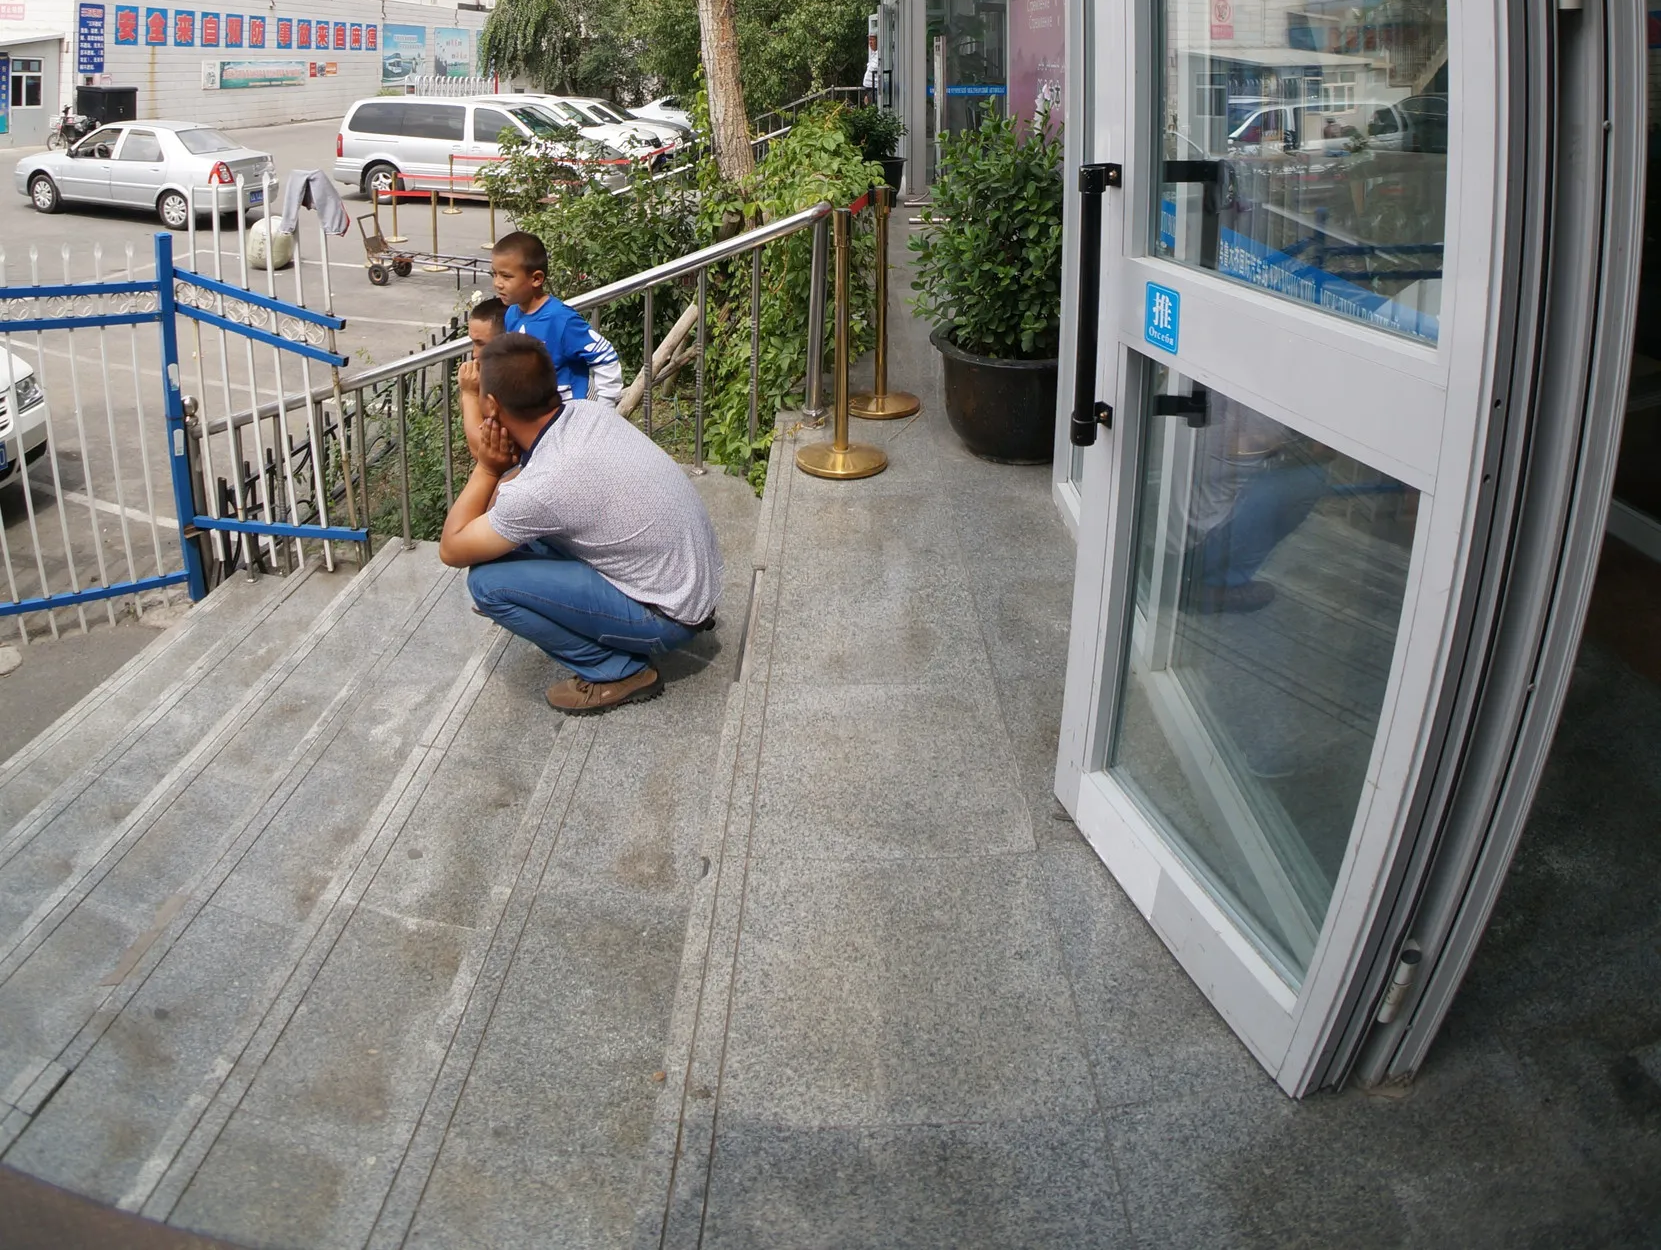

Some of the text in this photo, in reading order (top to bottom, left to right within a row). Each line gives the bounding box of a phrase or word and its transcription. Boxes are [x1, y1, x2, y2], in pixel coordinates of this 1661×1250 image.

[116, 9, 266, 46] 安全来自预防
[1152, 291, 1172, 330] 推
